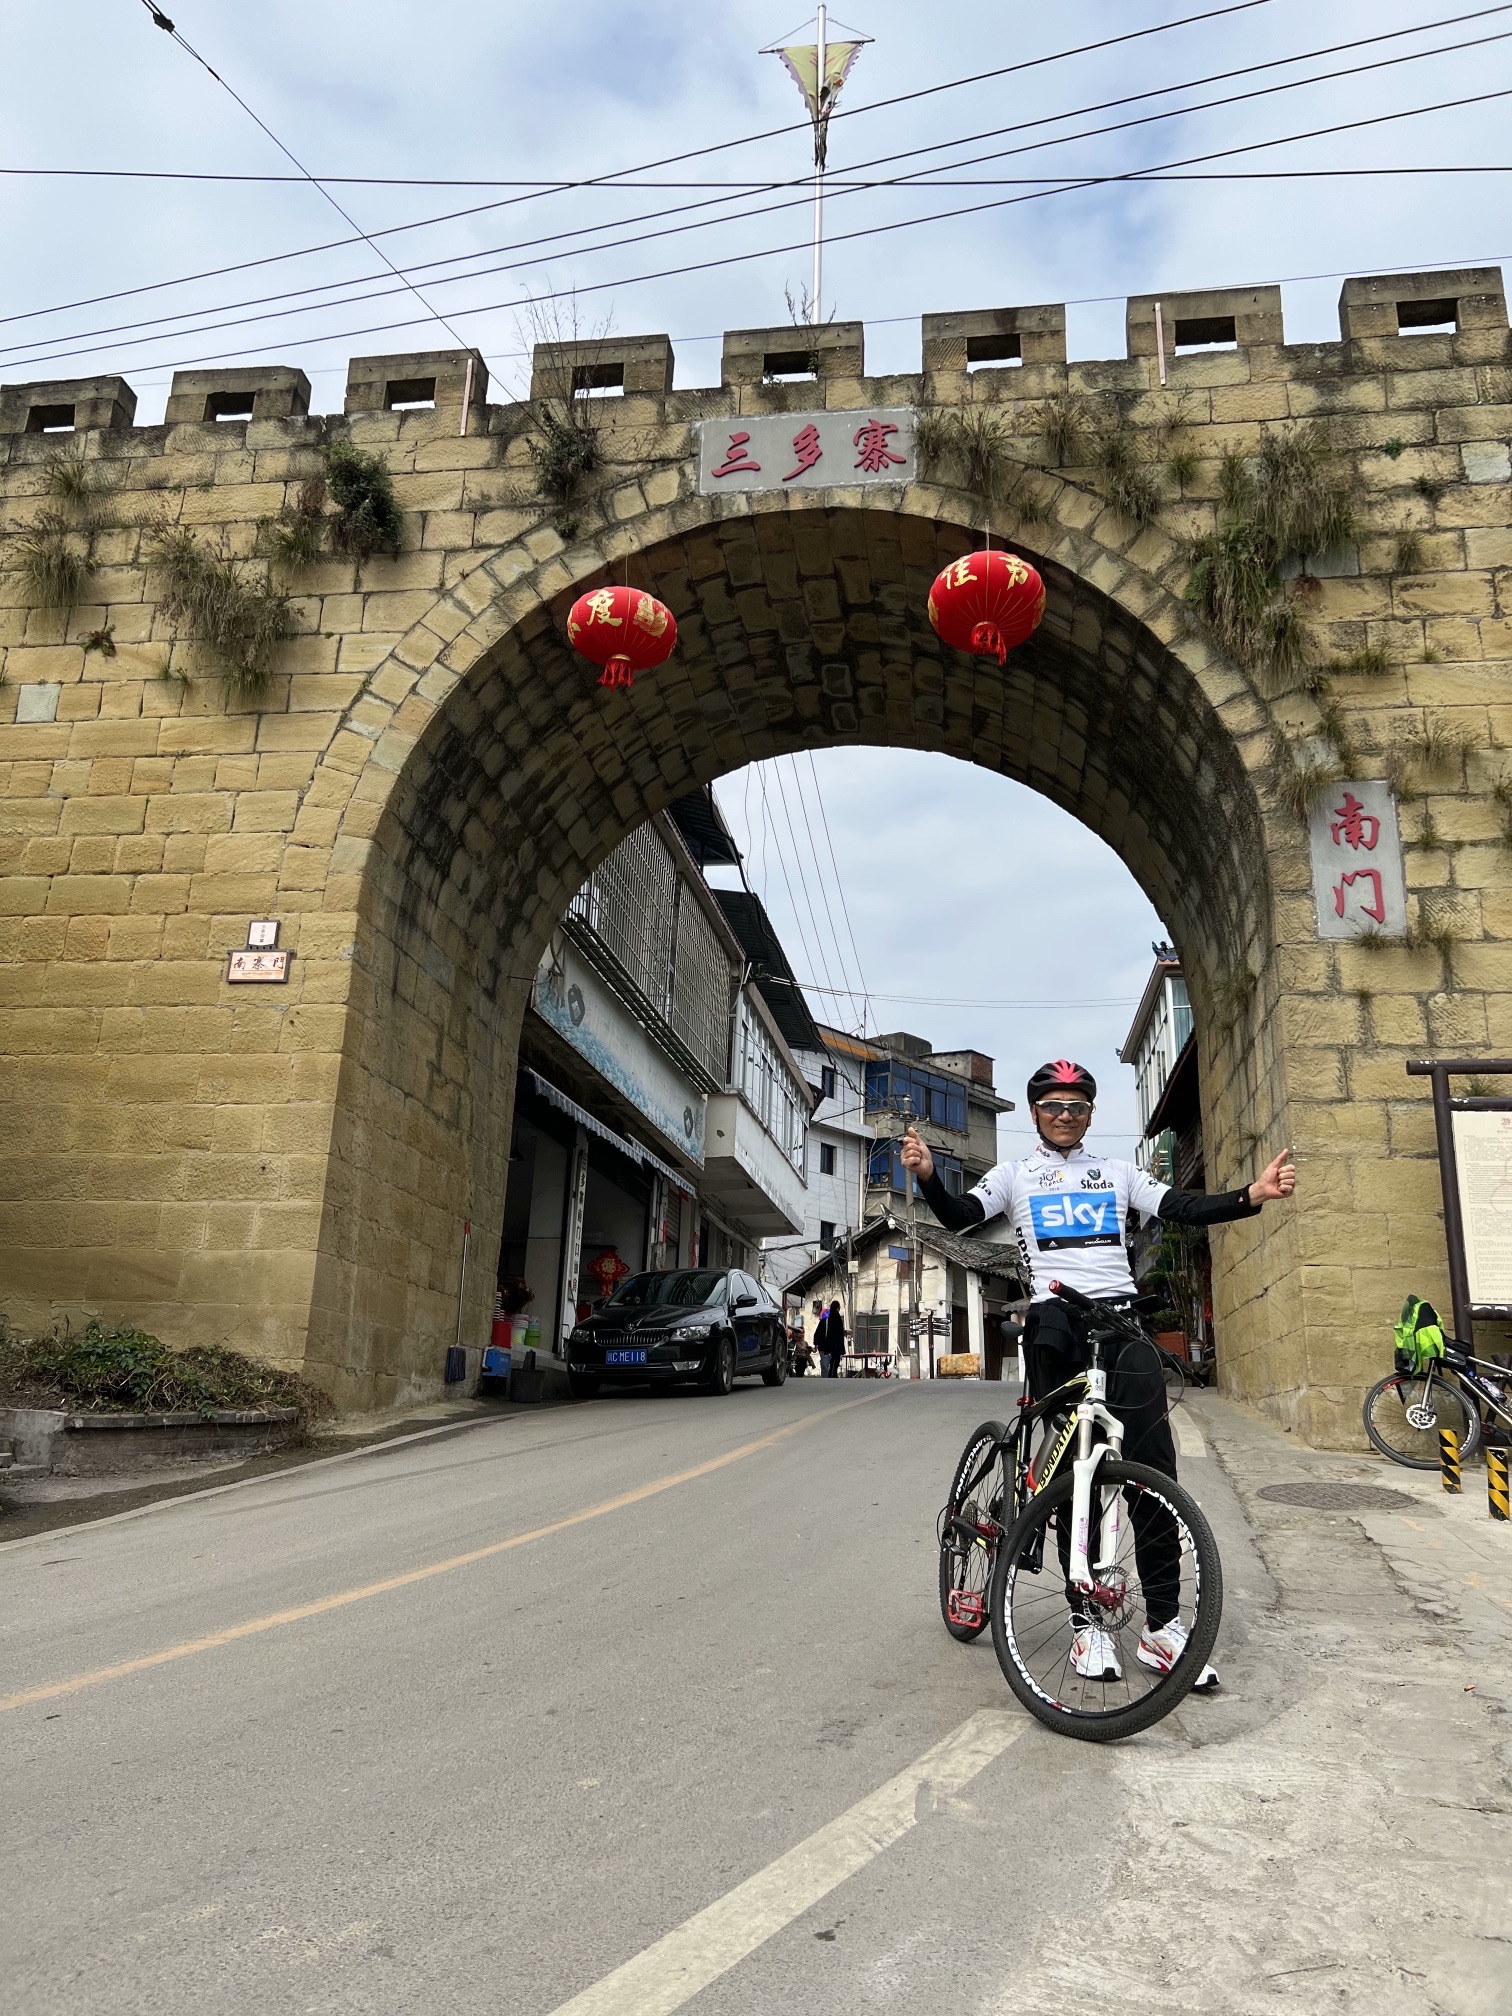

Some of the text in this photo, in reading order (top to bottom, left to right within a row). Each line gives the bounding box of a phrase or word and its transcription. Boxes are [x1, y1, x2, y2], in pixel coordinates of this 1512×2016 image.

[711, 419, 906, 482] 三多寨
[1331, 792, 1386, 924] 南门
[1041, 1195, 1108, 1232] sky
